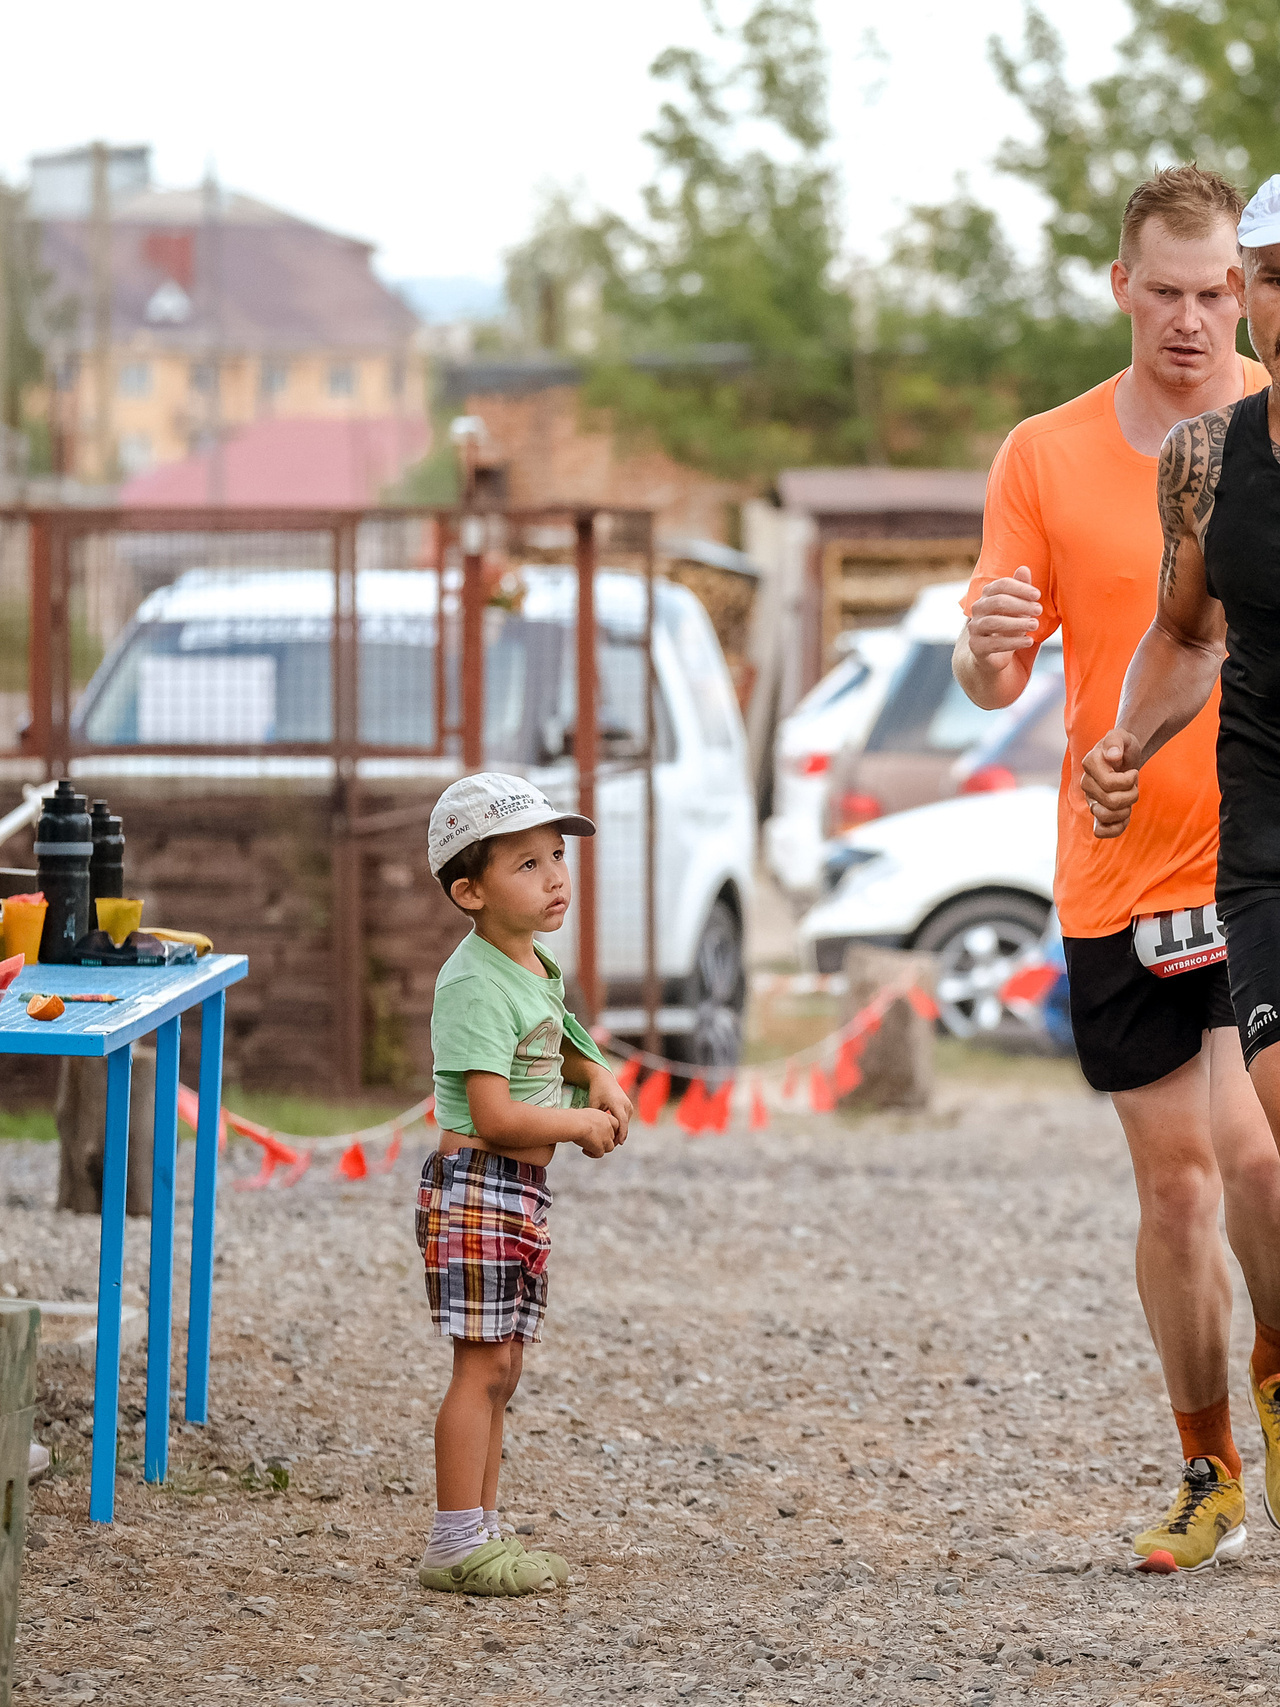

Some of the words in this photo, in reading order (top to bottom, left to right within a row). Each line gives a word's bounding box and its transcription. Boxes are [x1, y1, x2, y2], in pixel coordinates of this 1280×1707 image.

[455, 824, 471, 837] ONE
[1153, 904, 1227, 958] 11
[1163, 955, 1208, 974] ЛИТВЯКОВ
[1247, 1009, 1279, 1039] skinfit
